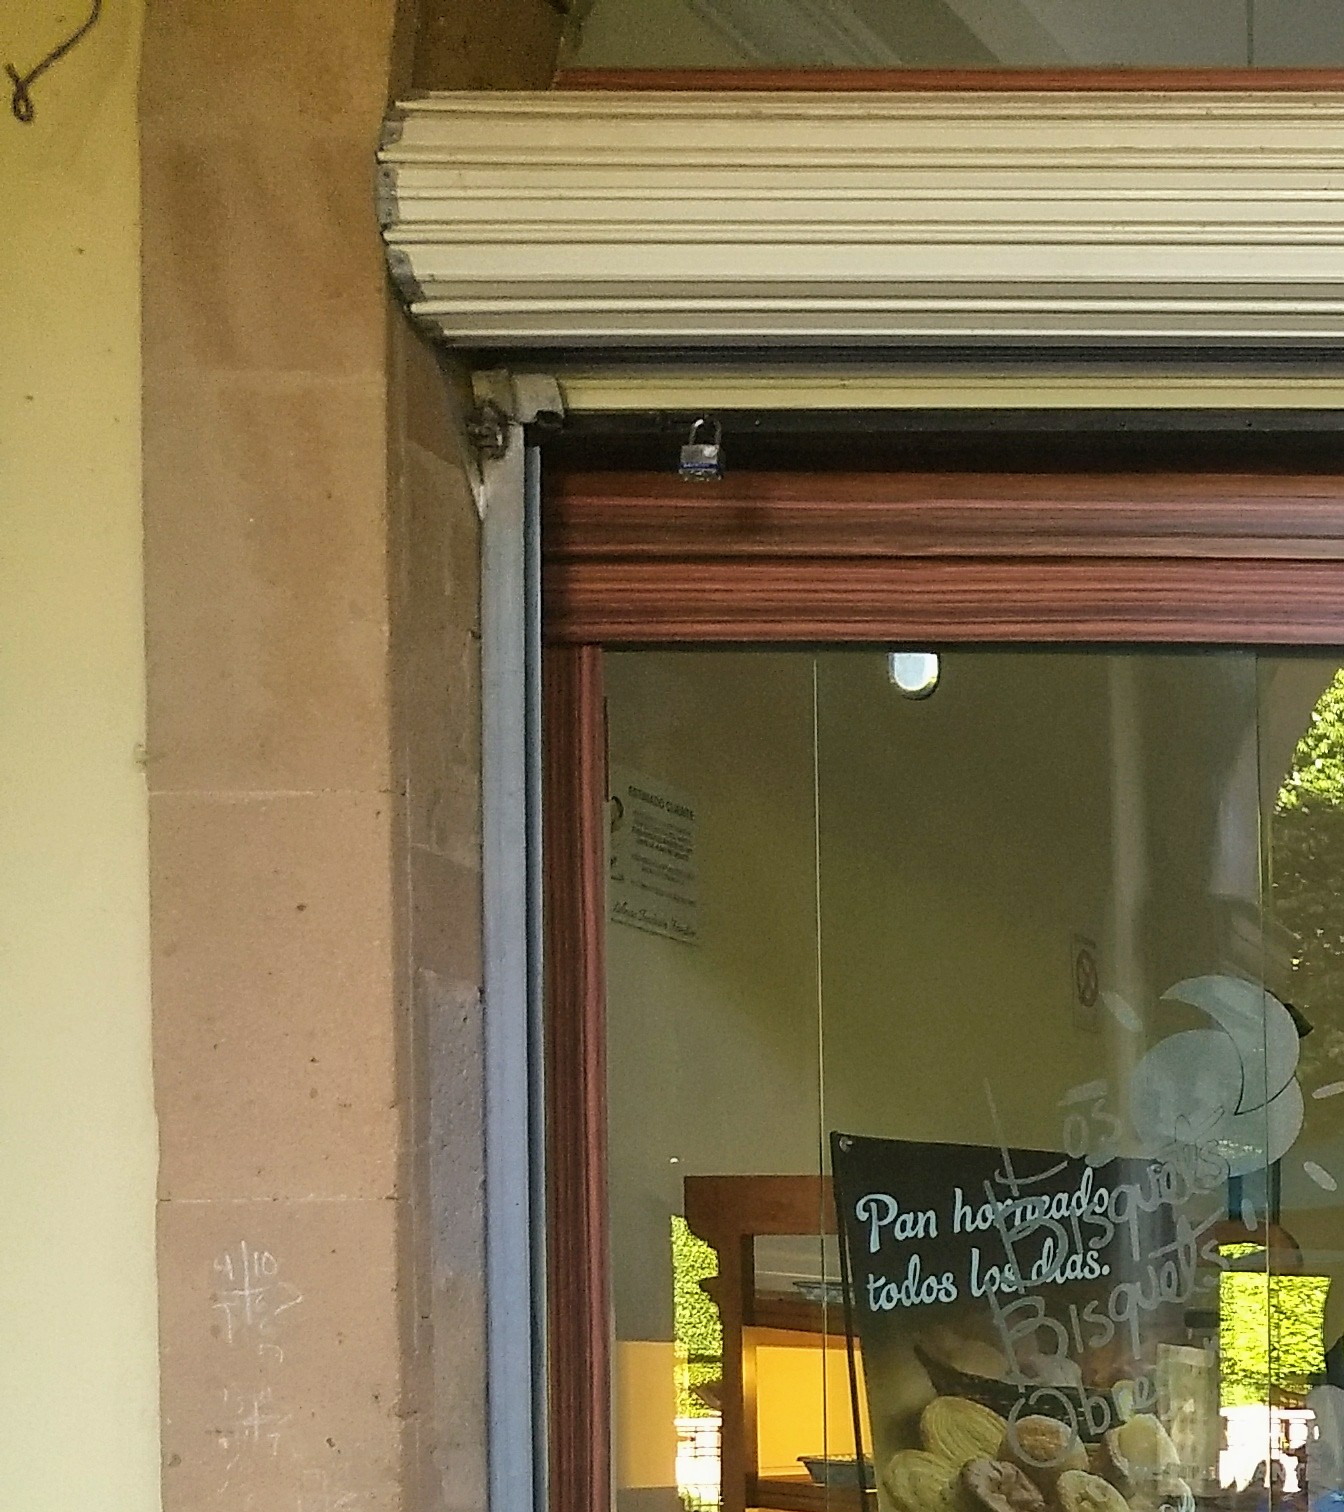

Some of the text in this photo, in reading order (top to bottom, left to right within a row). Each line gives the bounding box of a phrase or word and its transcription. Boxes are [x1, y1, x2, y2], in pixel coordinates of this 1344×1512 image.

[855, 1166, 1111, 1254] Pan horneado
[867, 1259, 957, 1312] todos
[970, 1247, 1017, 1298] los
